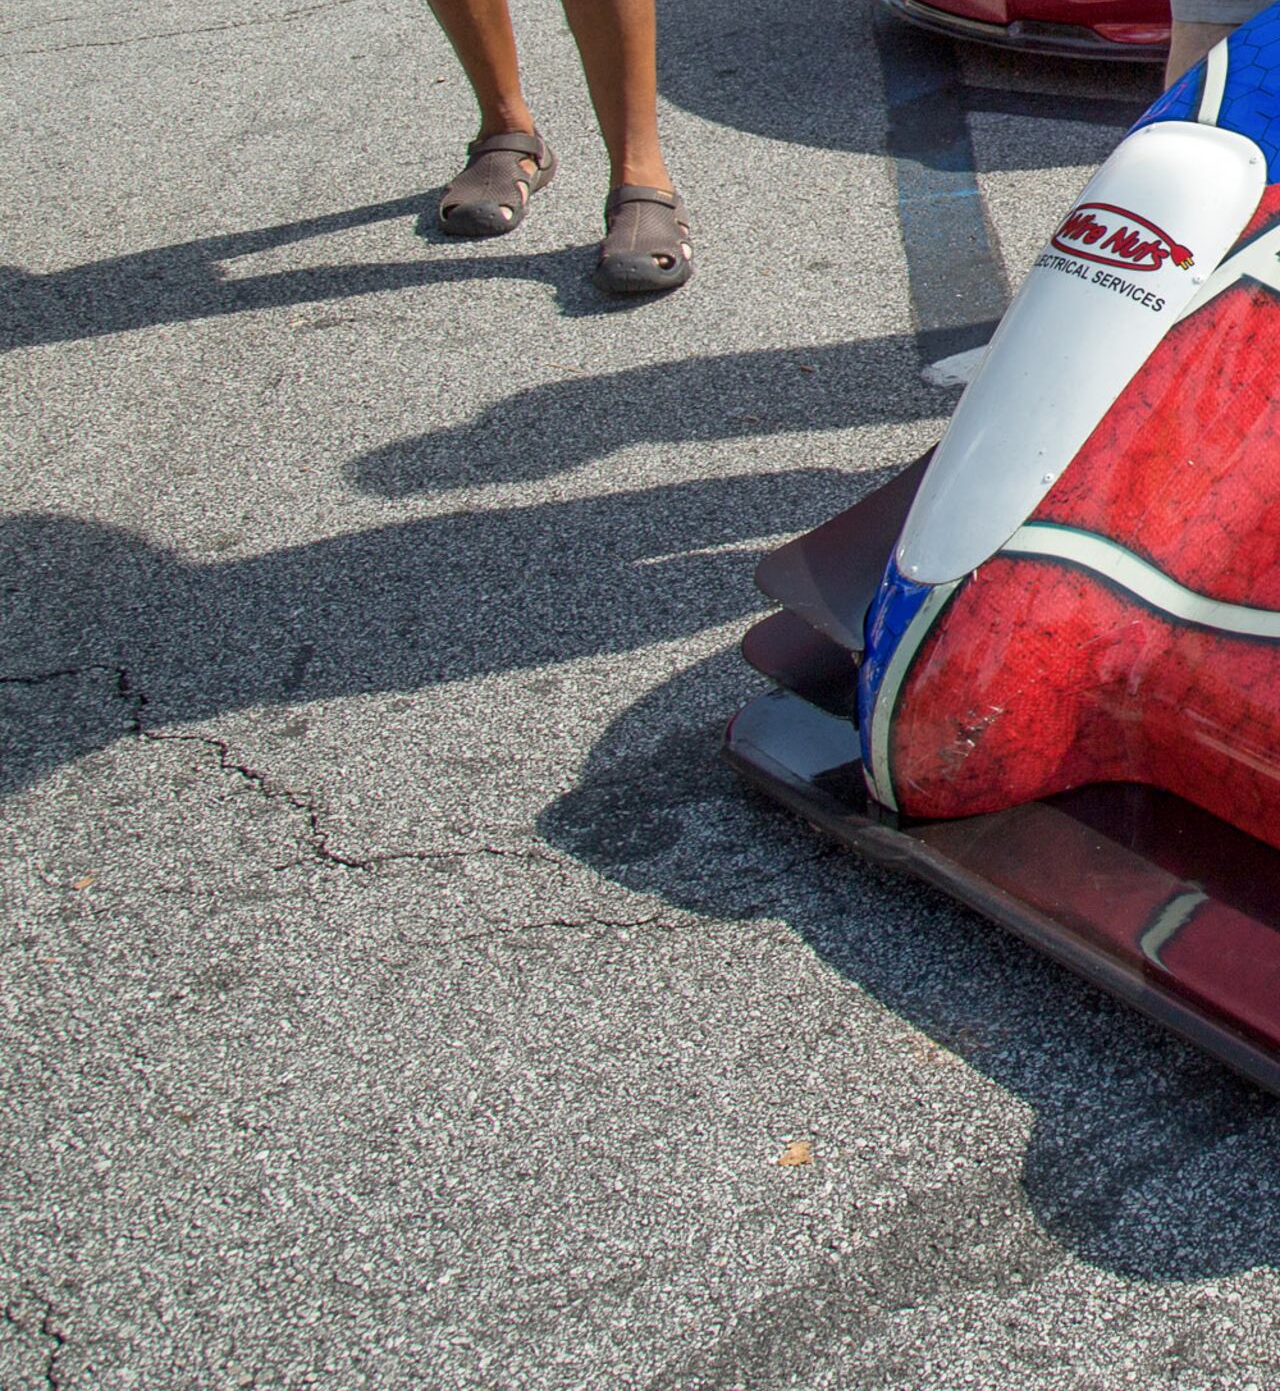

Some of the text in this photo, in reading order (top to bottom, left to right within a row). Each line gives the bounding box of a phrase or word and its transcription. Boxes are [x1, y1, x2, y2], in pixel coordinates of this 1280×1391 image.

[1056, 211, 1171, 266] Wire Nuts
[1091, 269, 1167, 313] SERVICES
